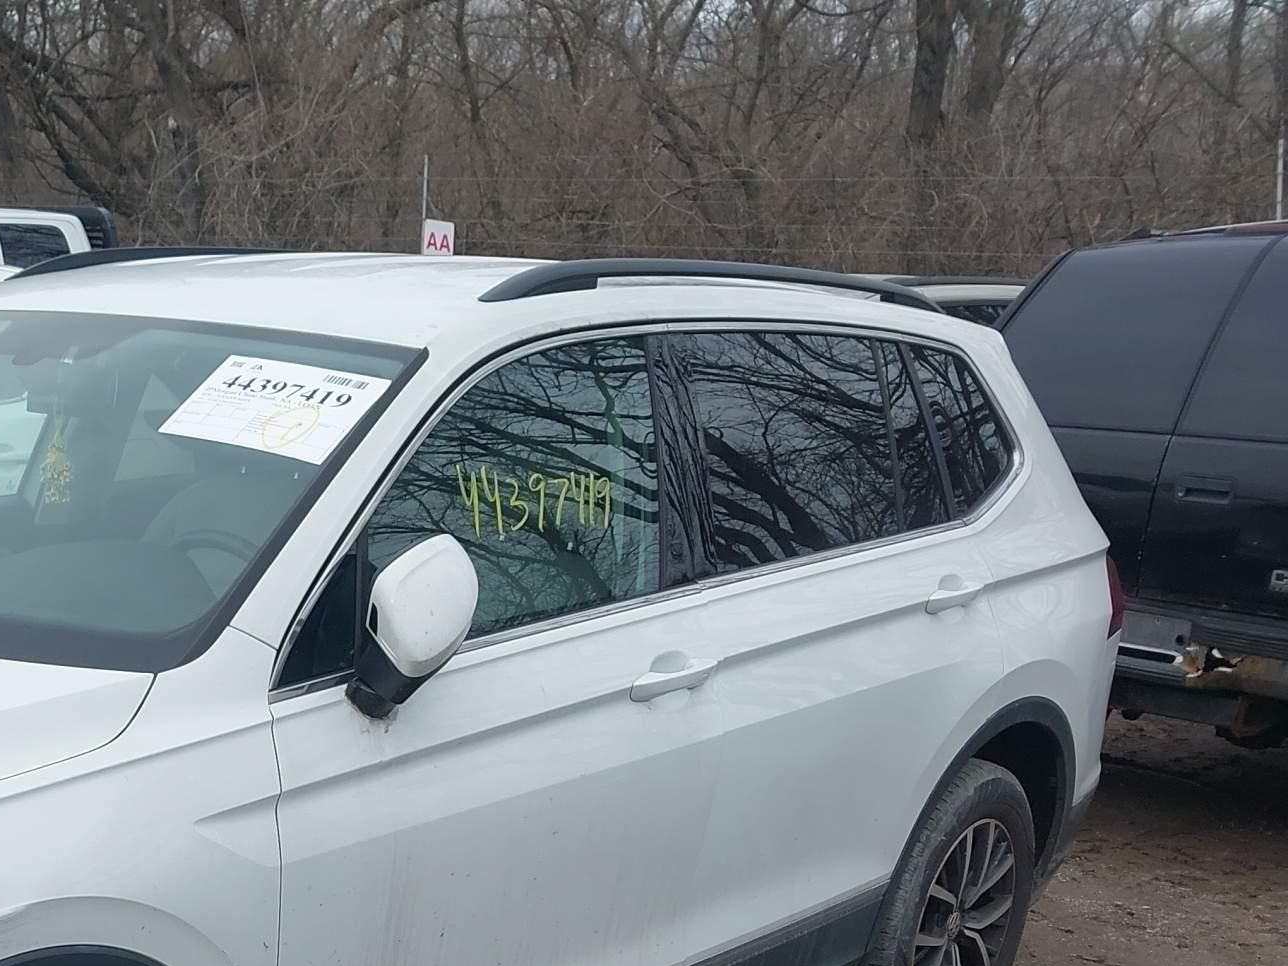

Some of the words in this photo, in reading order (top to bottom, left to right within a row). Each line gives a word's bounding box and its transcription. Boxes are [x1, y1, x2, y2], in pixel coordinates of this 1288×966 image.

[426, 231, 451, 253] AA
[222, 374, 353, 408] 44397419
[455, 463, 611, 541] 44397419
